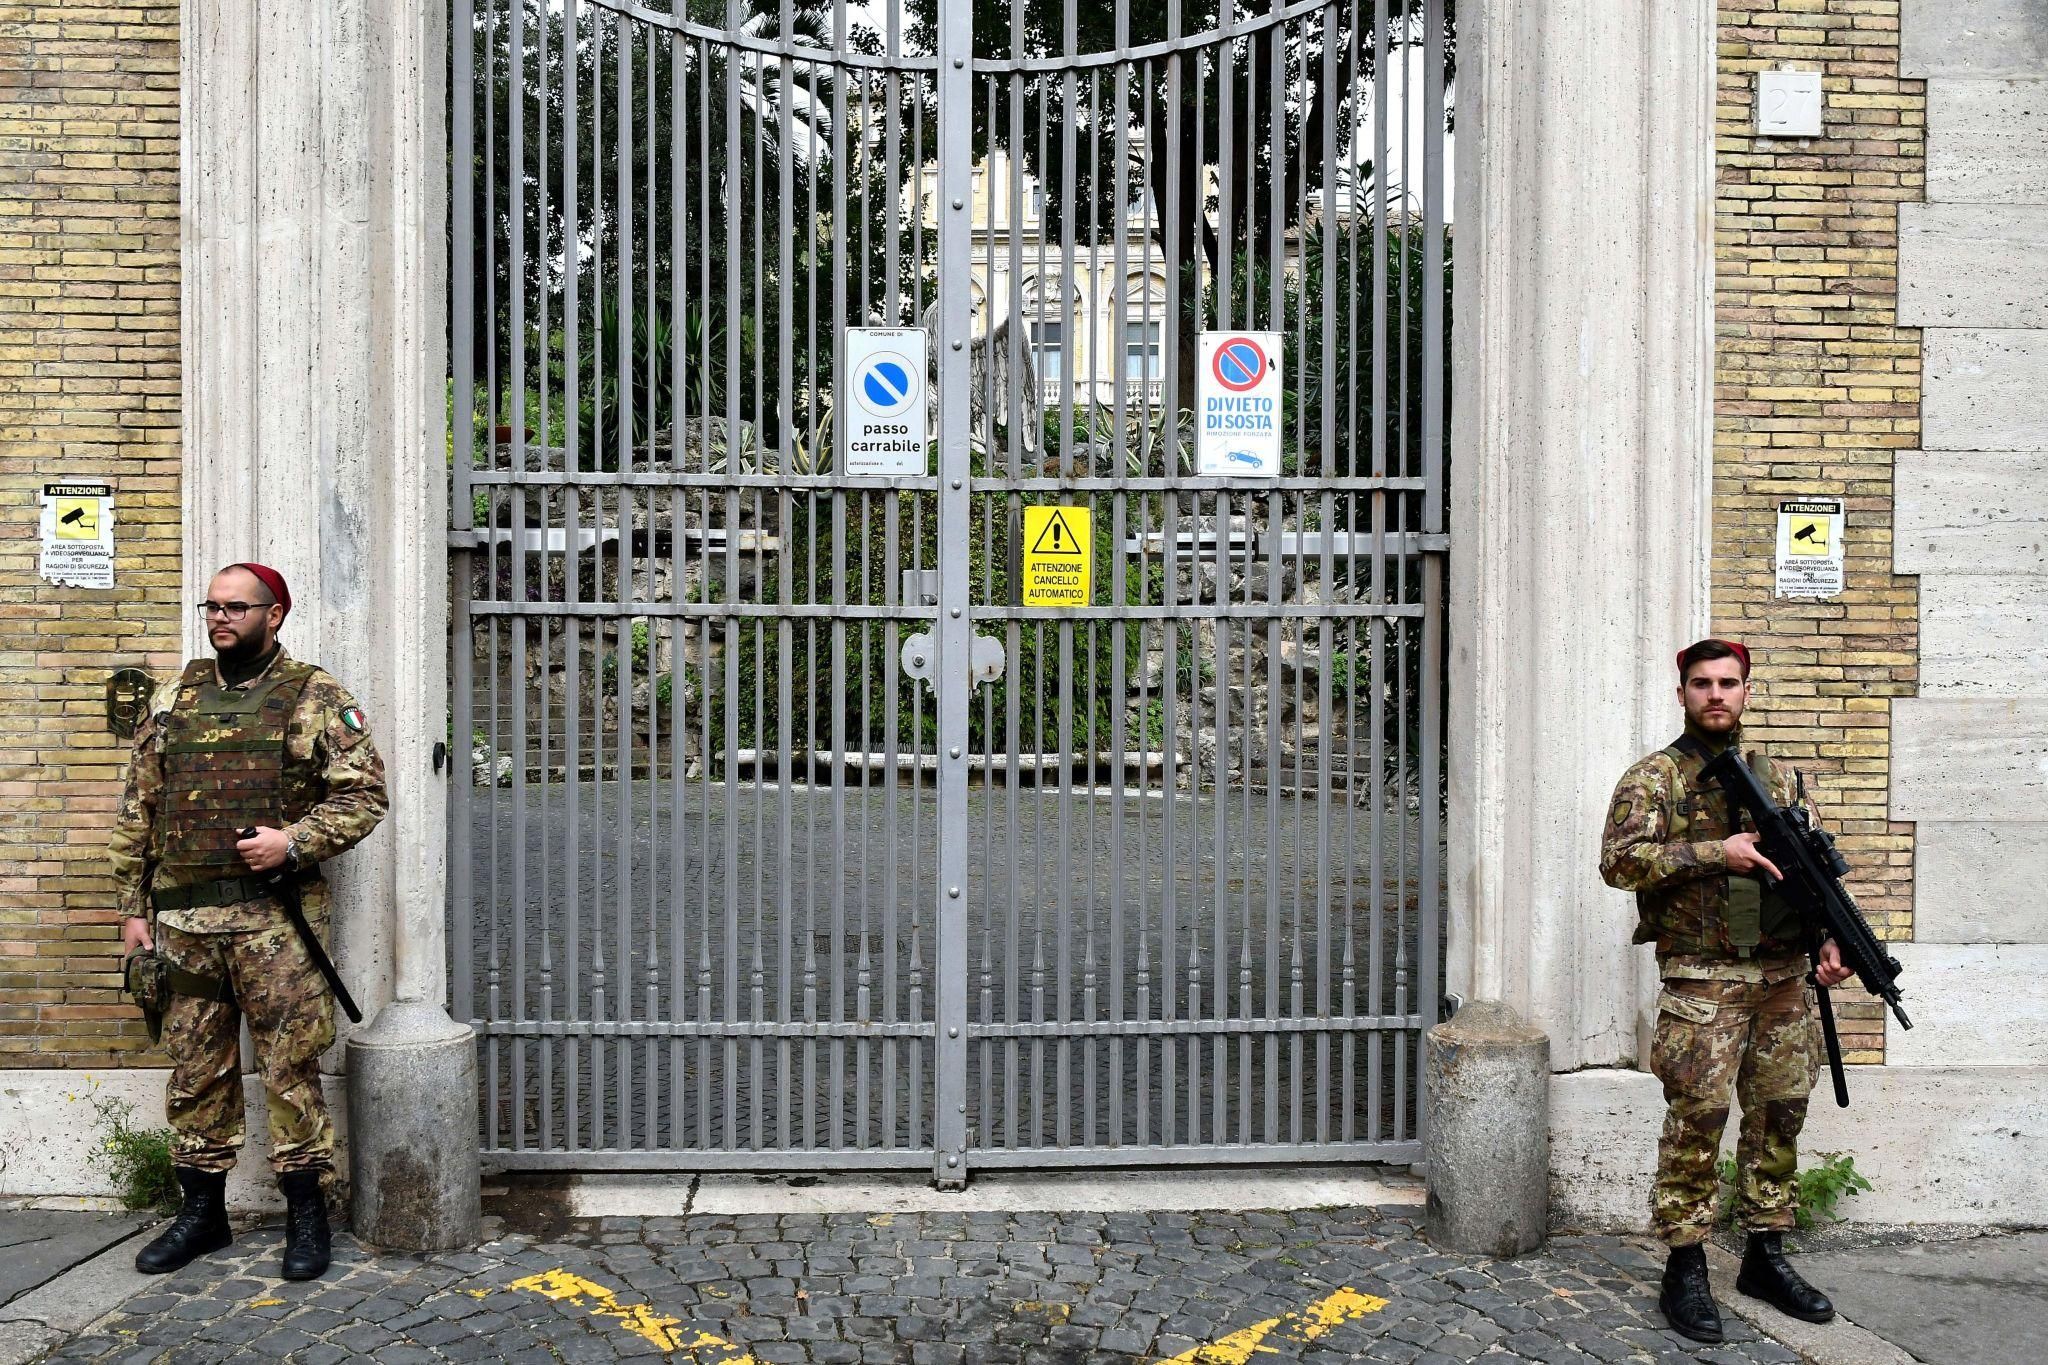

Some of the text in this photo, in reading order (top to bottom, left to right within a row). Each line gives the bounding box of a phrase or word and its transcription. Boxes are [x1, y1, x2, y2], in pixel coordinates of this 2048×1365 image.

[1768, 88, 1812, 125] 27
[1207, 396, 1273, 413] DIVIETO
[1206, 414, 1273, 430] DI SOSTA
[863, 424, 909, 437] passo
[851, 439, 921, 452] carrabile
[49, 486, 106, 495] ATTENZIONE!
[1784, 503, 1836, 513] ATTENZIONE!
[1031, 562, 1083, 573] ATTENZIONE
[1033, 575, 1079, 585] CANCELLO
[1028, 588, 1084, 599] AUTOMATICO
